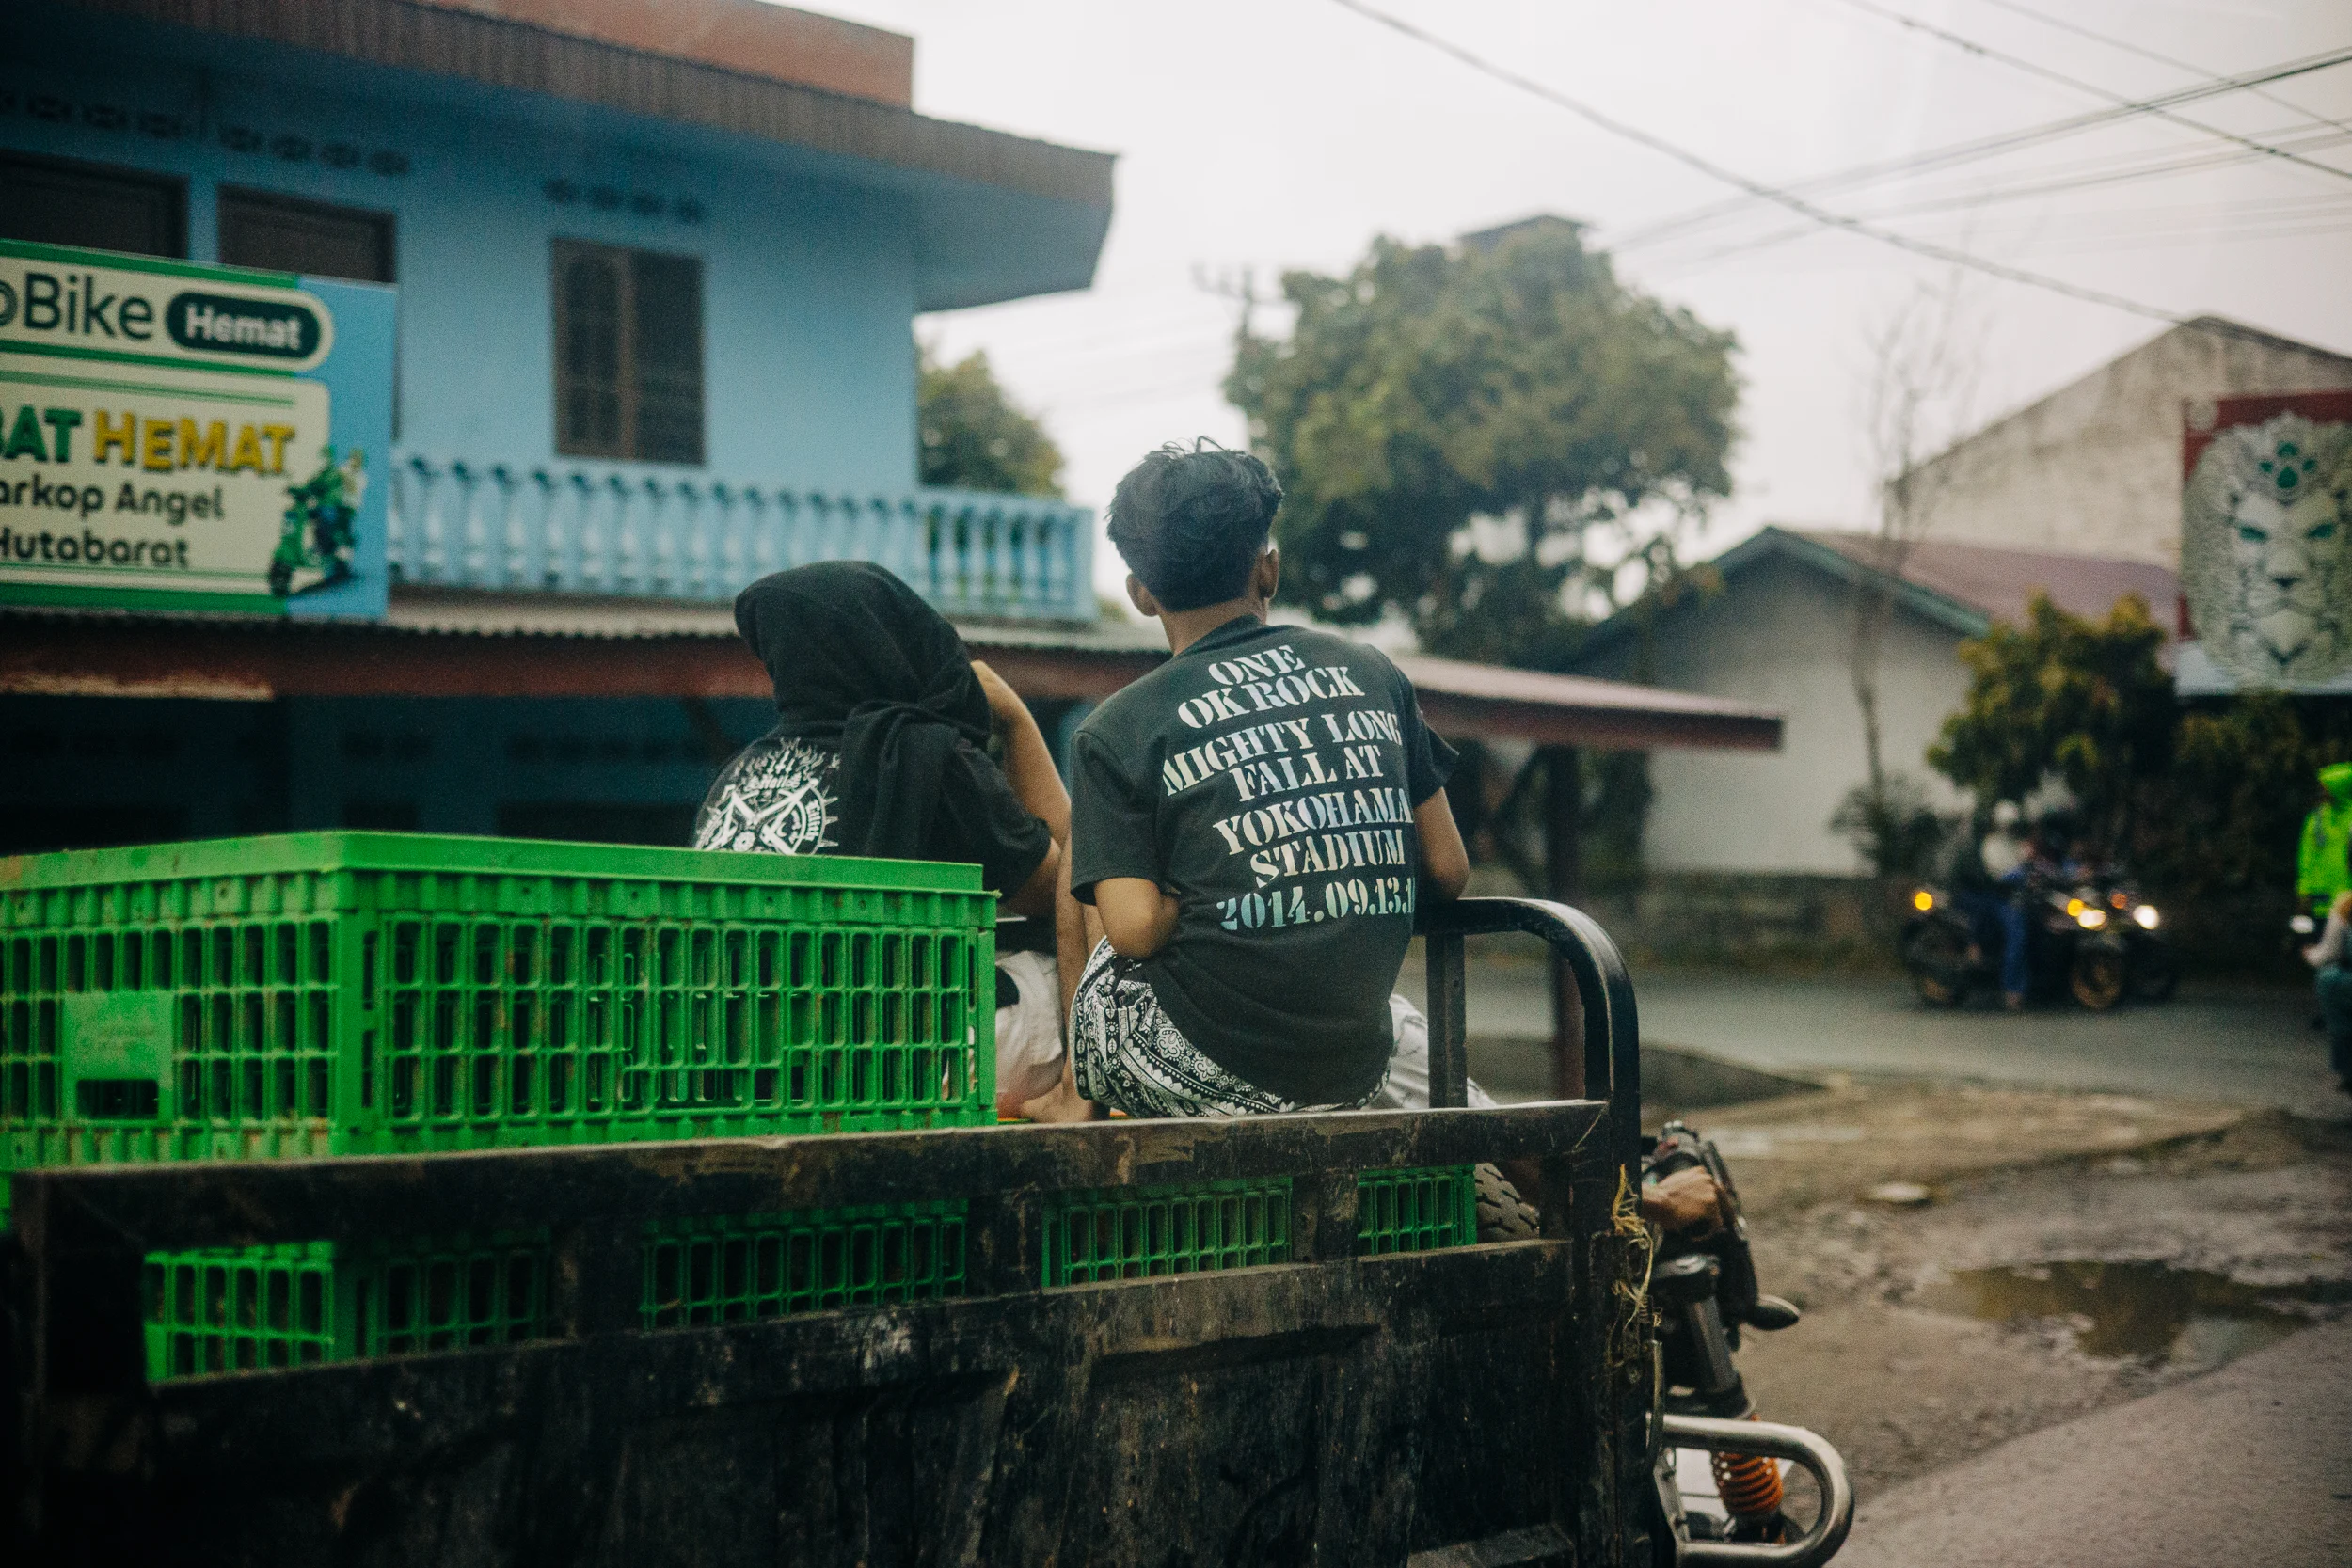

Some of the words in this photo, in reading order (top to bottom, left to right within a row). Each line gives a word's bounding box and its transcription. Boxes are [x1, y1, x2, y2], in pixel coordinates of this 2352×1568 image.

[187, 302, 302, 349] Hemat
[0, 404, 83, 463] AT
[95, 408, 295, 474] HEMAT
[115, 481, 226, 525] Angel
[1208, 645, 1306, 686] ONE
[1178, 688, 1250, 729] OK
[1241, 666, 1365, 711] ROCK
[1162, 718, 1314, 797] MIGHTY
[1321, 710, 1403, 746] LONG
[1229, 752, 1338, 802] FALL
[1343, 745, 1384, 780] AT
[1213, 787, 1415, 855] YOKOHAMA
[1249, 829, 1406, 888] STADIUM
